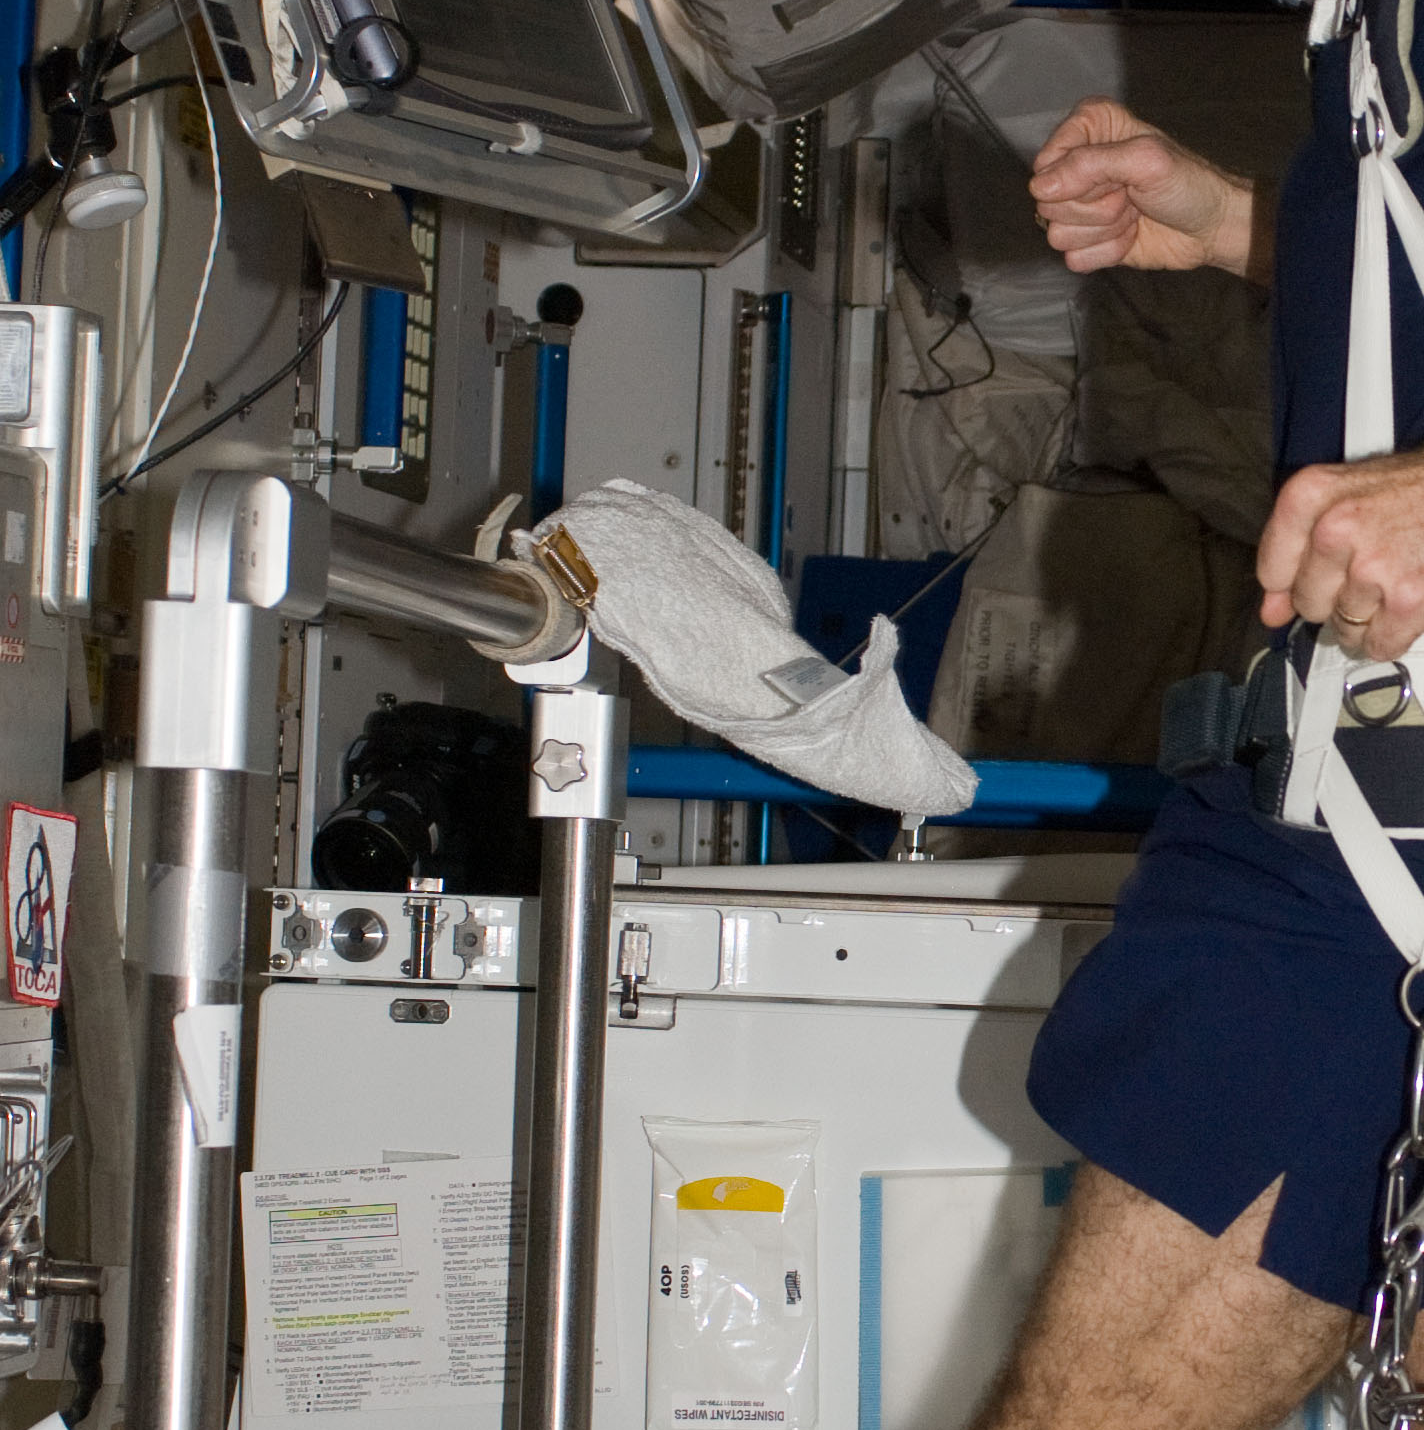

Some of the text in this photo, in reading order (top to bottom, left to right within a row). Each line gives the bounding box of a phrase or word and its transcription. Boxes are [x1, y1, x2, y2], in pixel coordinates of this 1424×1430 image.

[14, 964, 58, 996] TOCA
[318, 1209, 348, 1217] CAUTION
[679, 1264, 690, 1298] (USOS)
[674, 1408, 785, 1422] DISINFECTANT WIPES
